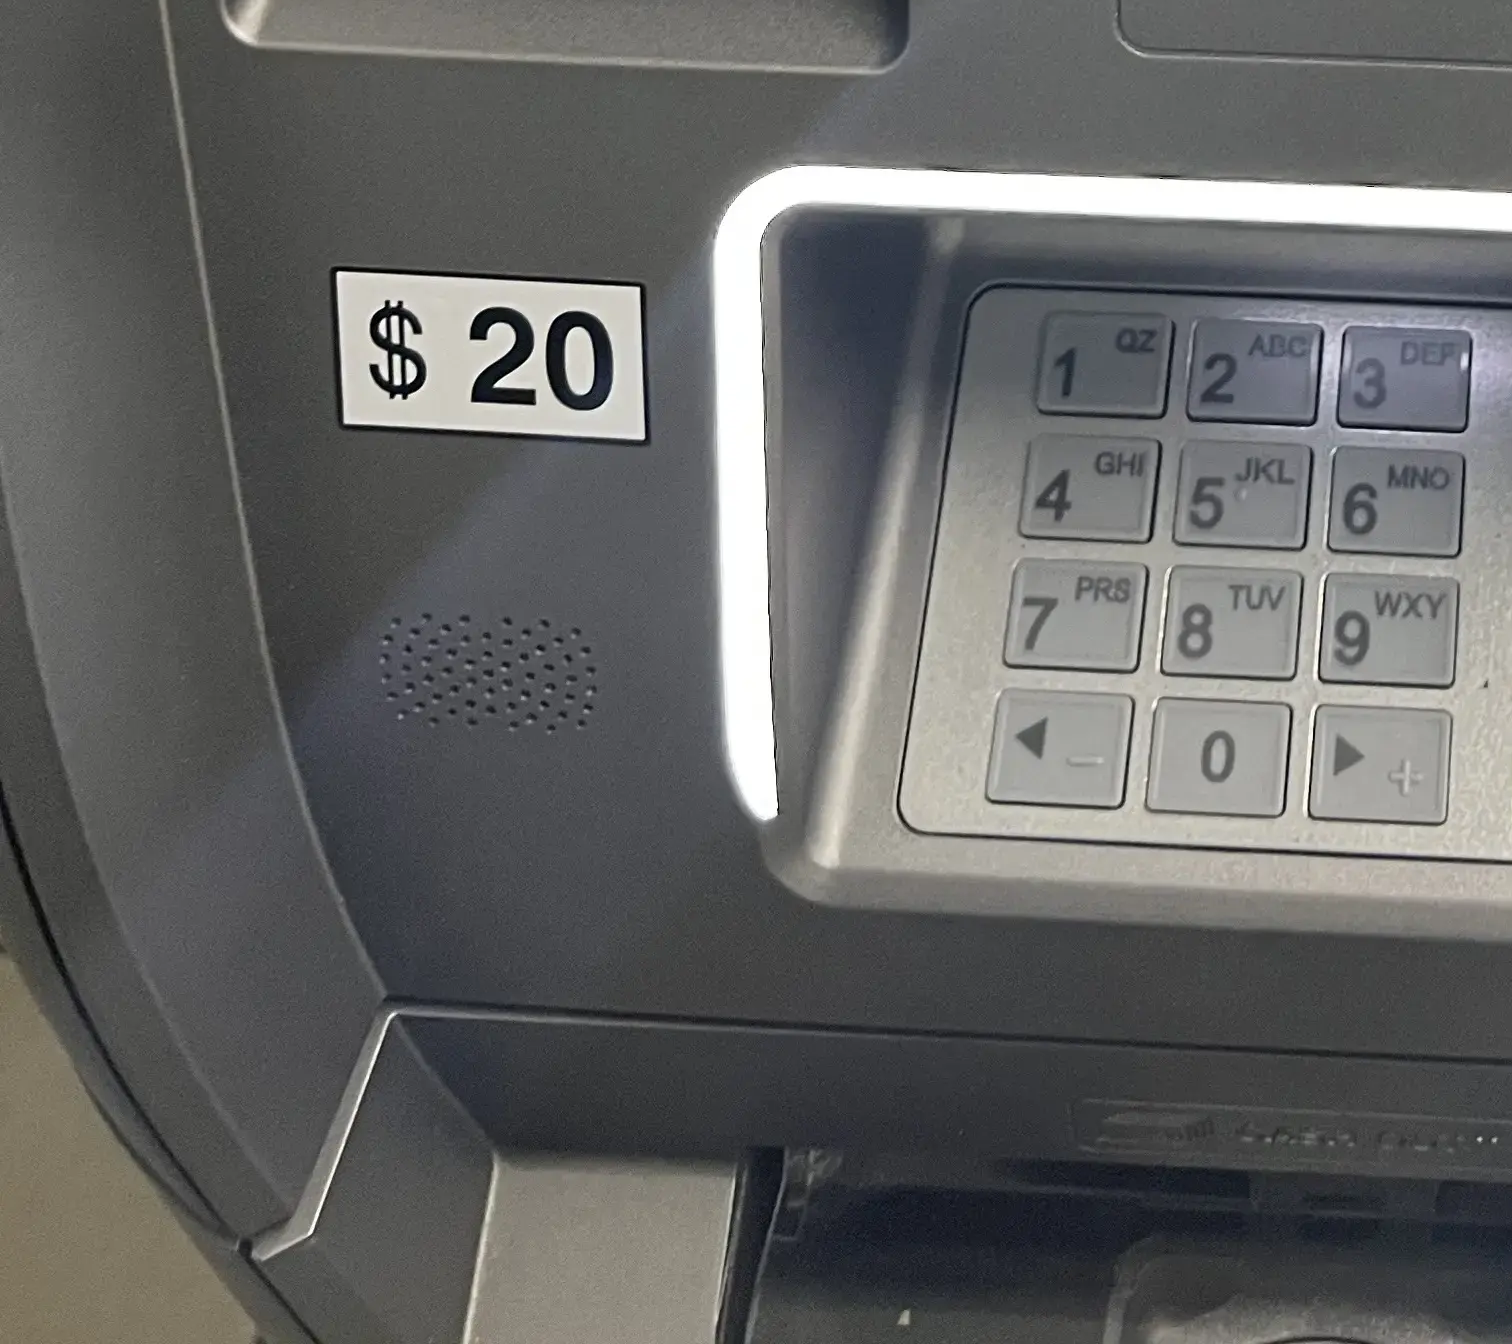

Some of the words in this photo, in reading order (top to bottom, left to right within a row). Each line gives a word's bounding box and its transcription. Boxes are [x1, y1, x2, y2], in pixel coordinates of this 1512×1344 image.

[368, 299, 427, 400] $
[469, 306, 614, 411] 20
[1115, 328, 1158, 354] QZ
[1248, 332, 1309, 359] ABC
[1053, 346, 1078, 398] 1
[1200, 352, 1239, 404] 2
[1352, 357, 1387, 409] 3
[1094, 451, 1146, 477] GHI
[1235, 458, 1295, 485] JKL
[1387, 463, 1452, 490] MNO
[1035, 469, 1072, 523] 4
[1189, 477, 1226, 530] 5
[1342, 482, 1379, 536] 6
[1075, 576, 1131, 604] PRS
[1229, 584, 1286, 612] TUV
[1374, 591, 1447, 620] WXY
[1022, 596, 1058, 651] 7
[1177, 603, 1214, 659] 8
[1333, 611, 1371, 666] 9
[1201, 730, 1236, 783] 0
